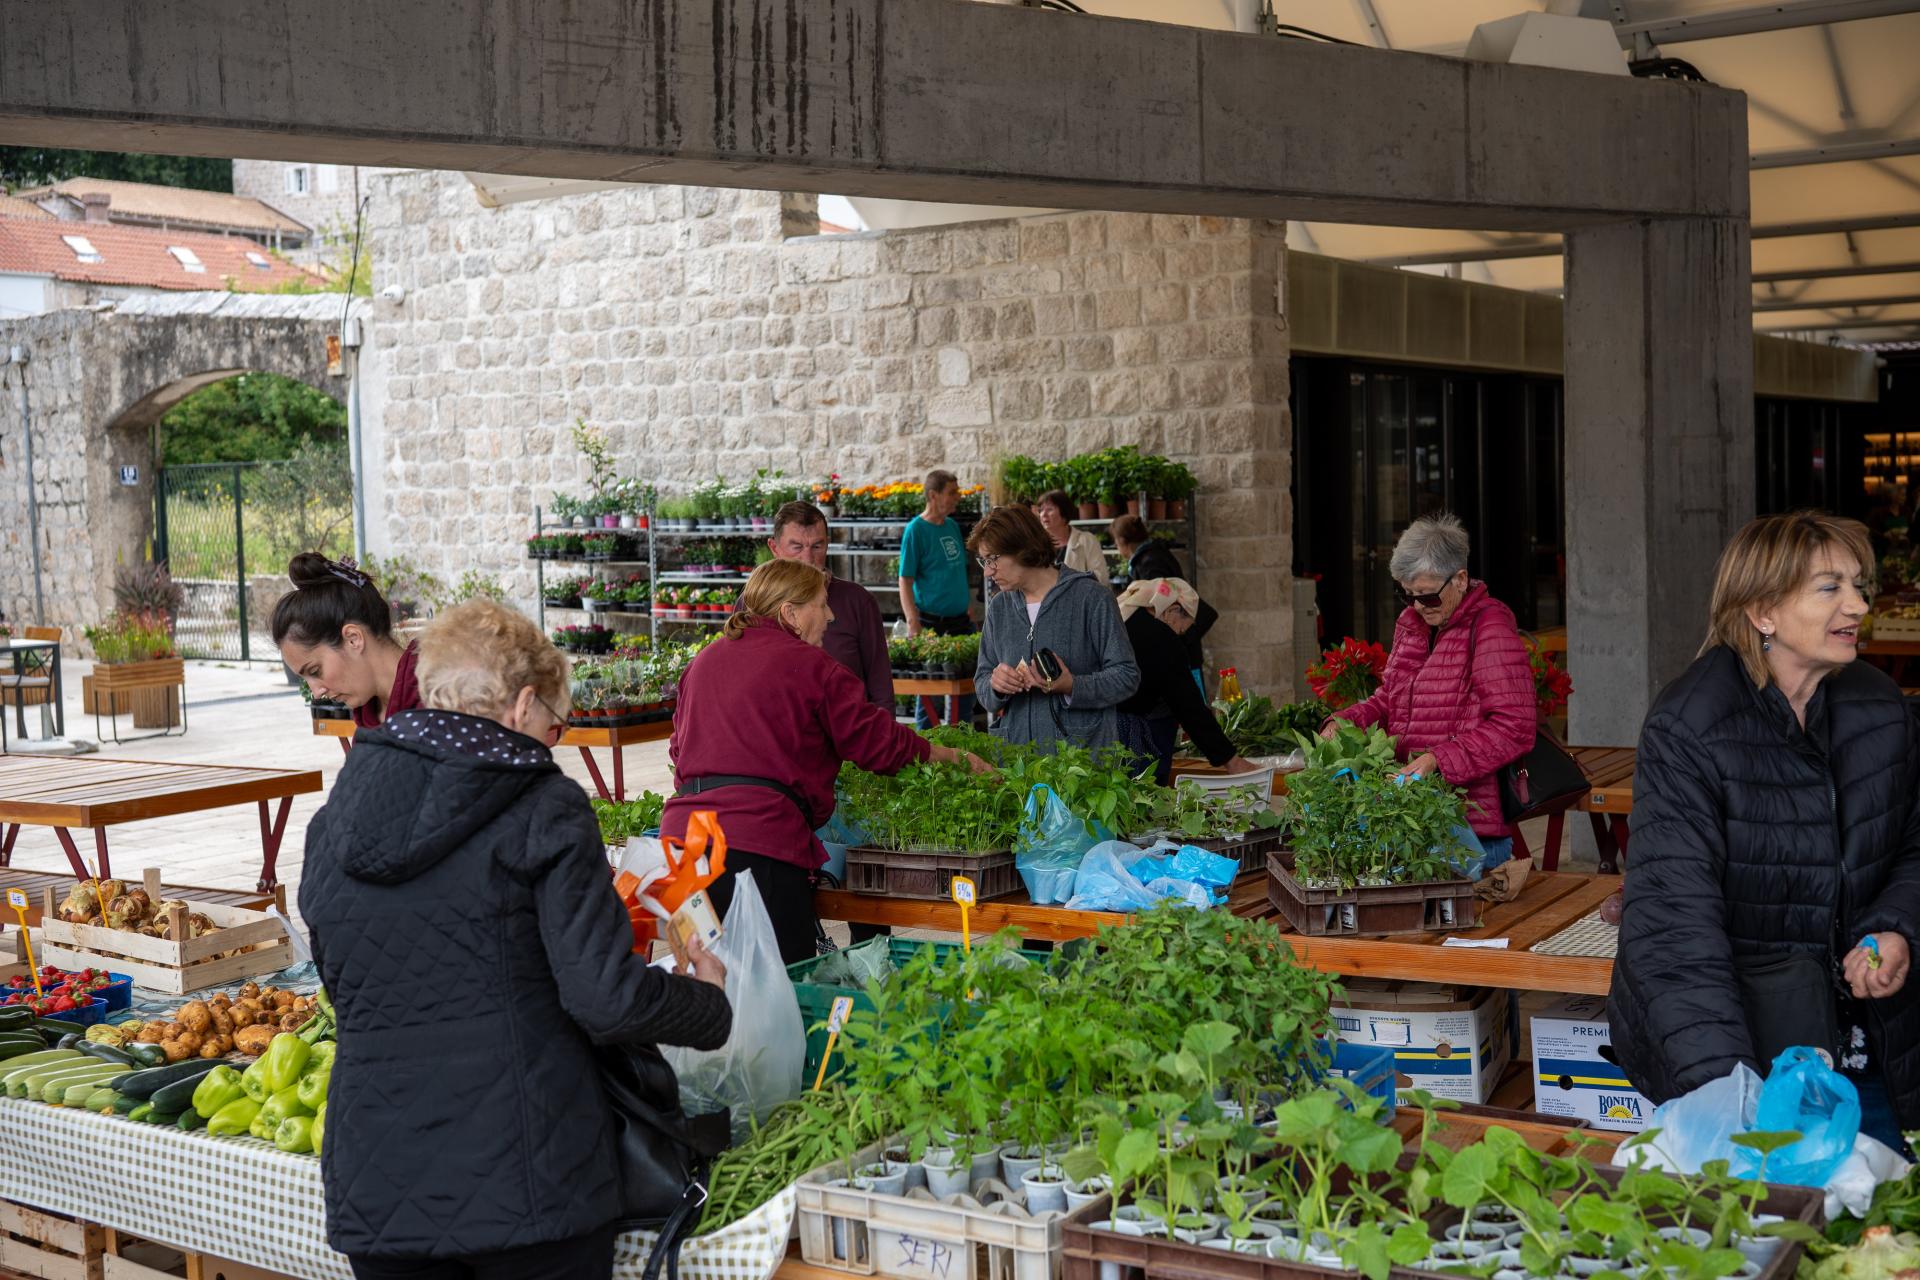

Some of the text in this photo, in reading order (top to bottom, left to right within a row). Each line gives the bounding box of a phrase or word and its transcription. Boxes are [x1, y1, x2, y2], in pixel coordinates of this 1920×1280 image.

[691, 894, 703, 908] 50
[1572, 1026, 1610, 1037] PREMI
[1598, 1095, 1643, 1117] BONITA
